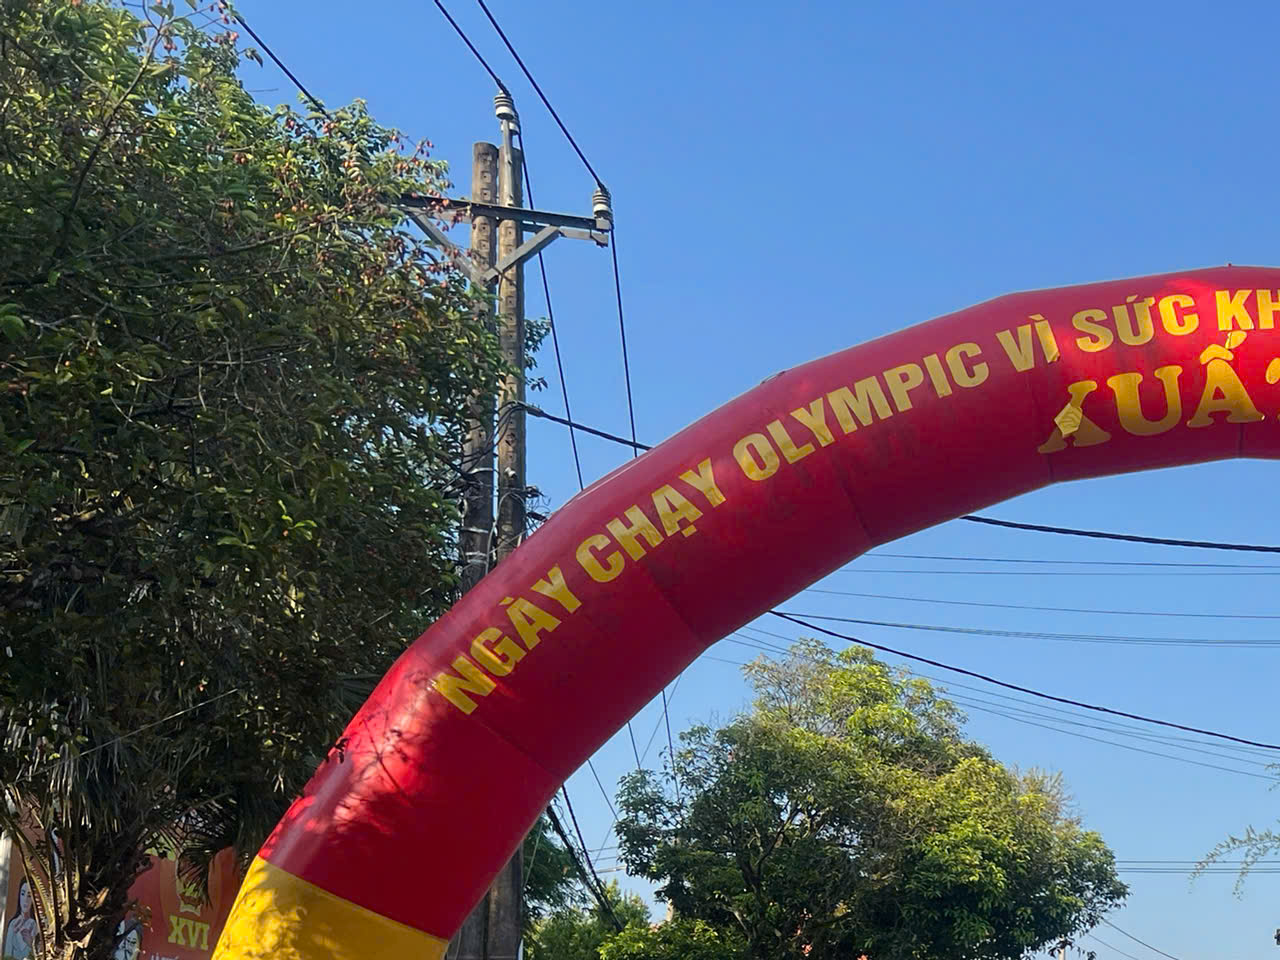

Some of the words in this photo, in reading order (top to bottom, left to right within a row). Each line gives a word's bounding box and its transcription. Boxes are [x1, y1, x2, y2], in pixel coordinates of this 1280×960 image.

[435, 565, 582, 715] NGÀY
[575, 457, 724, 583] CHẠY
[732, 342, 989, 482] OLYMPIC
[996, 314, 1061, 372] VÌ
[1071, 294, 1200, 353] SỨC
[168, 915, 210, 951] XVI
